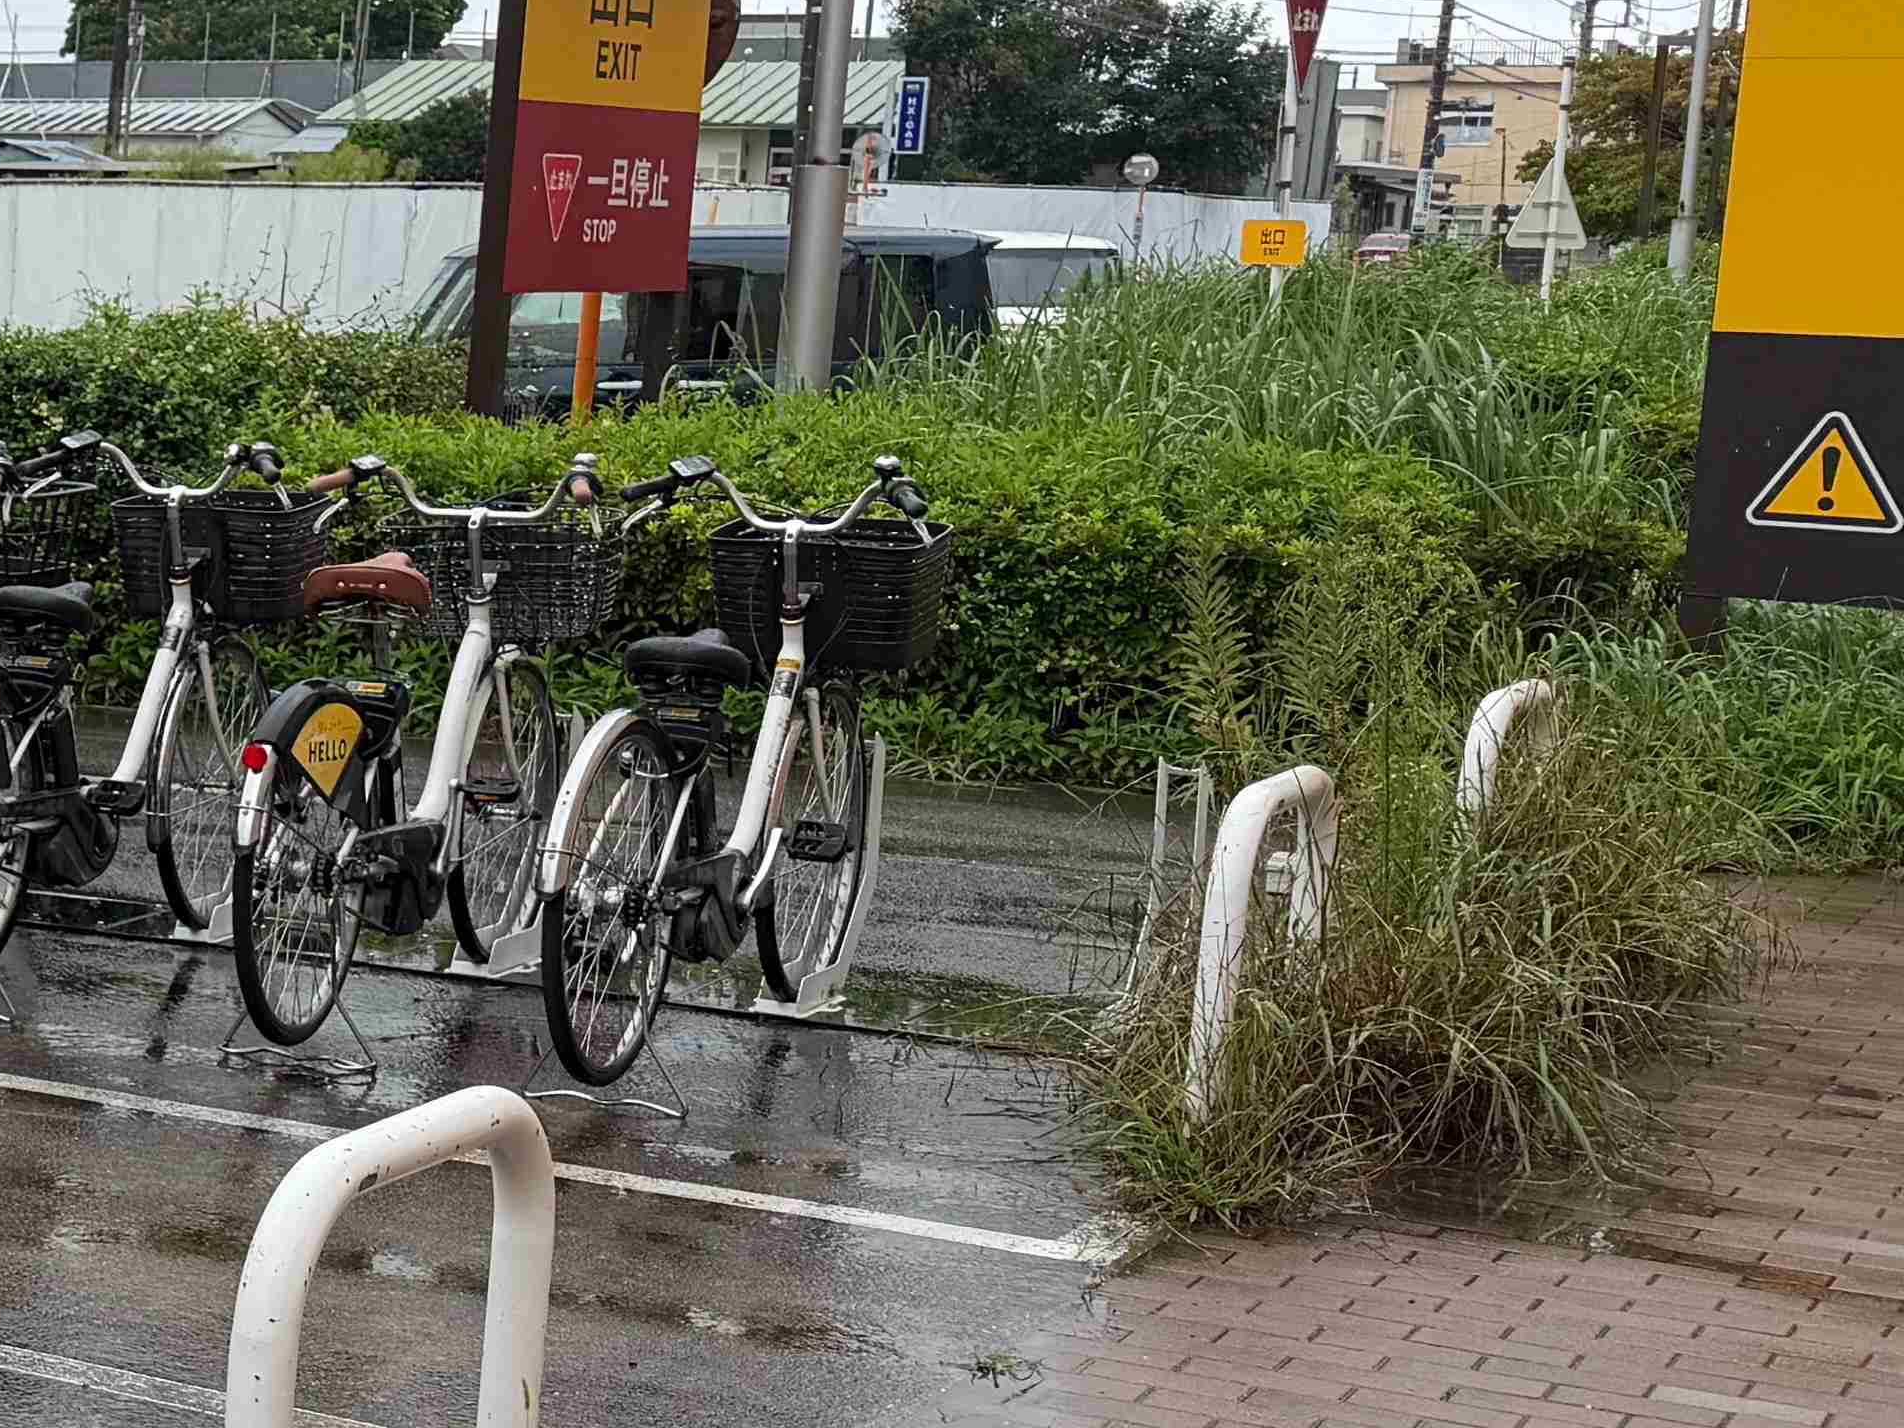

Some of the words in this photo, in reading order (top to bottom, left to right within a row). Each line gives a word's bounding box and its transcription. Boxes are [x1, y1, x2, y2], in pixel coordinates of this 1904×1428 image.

[595, 40, 642, 82] EXIT
[587, 157, 670, 209] 一旦停止
[583, 218, 617, 243] STOP
[1260, 228, 1286, 245] 出口
[308, 737, 347, 764] HELLO
